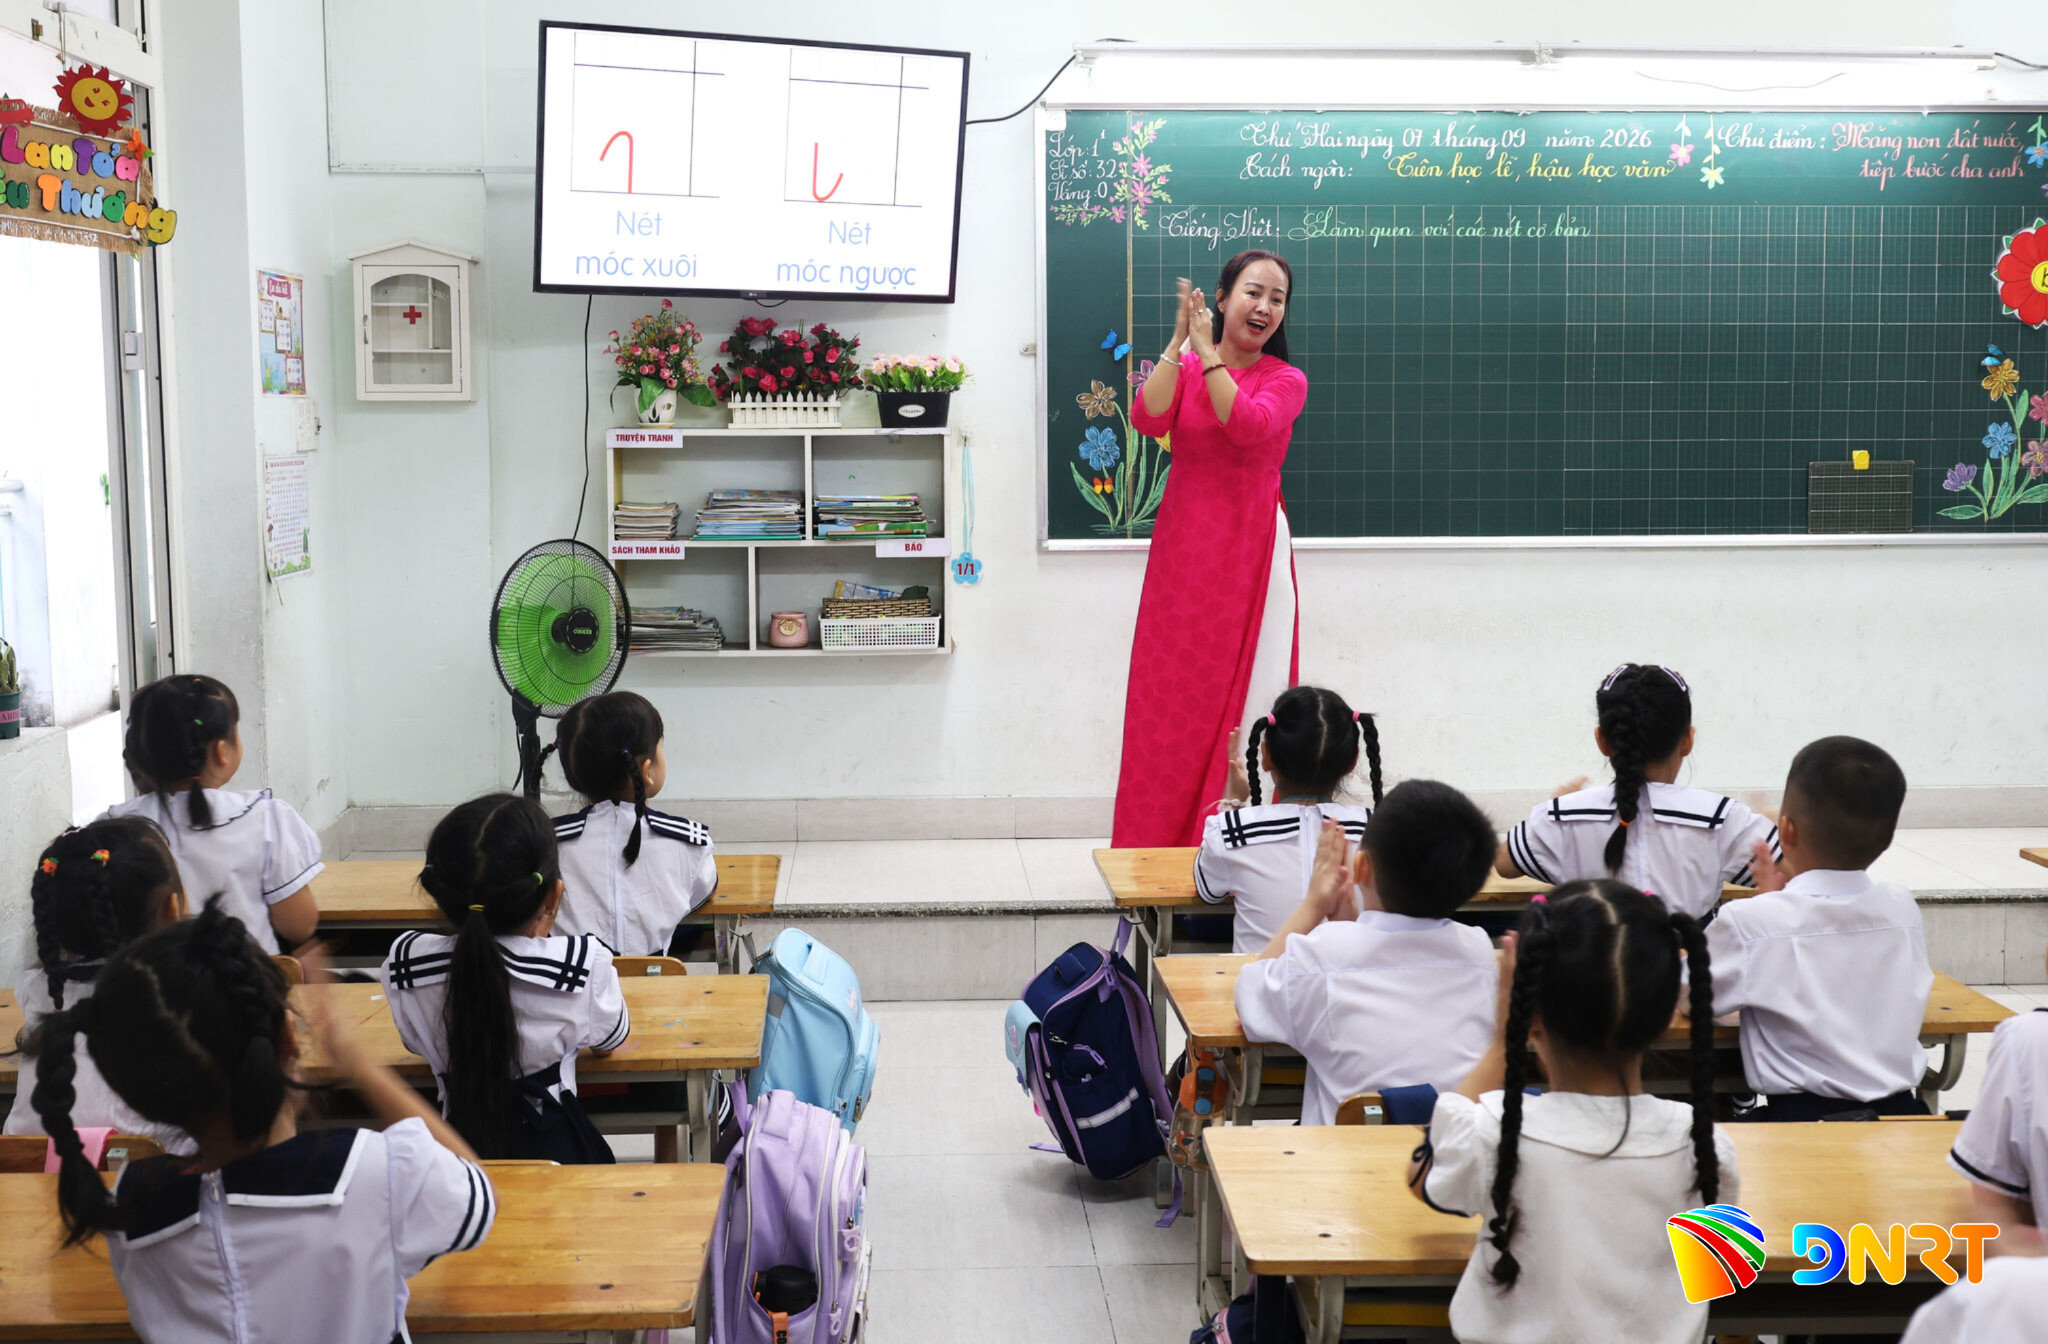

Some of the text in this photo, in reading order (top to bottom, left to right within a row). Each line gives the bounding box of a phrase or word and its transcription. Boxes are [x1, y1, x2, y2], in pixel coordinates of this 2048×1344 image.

[1240, 120, 1301, 147] Thứ
[1300, 121, 1343, 149] Hai
[1402, 128, 1423, 147] 07
[1430, 120, 1501, 160] tháng
[1501, 128, 1526, 148] 09
[1545, 128, 1595, 147] năm
[1599, 128, 1654, 148] 2026
[1717, 121, 1766, 148] Chủ
[1832, 121, 1902, 161] Măng
[1906, 135, 1941, 149] non
[1947, 119, 1980, 148] đất
[1096, 158, 1118, 179] 32
[1240, 151, 1353, 190] Cách ngôn:
[1387, 151, 1443, 178] Tiên
[1447, 151, 1483, 183] học
[1526, 152, 1572, 182] hậu
[1577, 152, 1618, 183] học
[1623, 158, 1676, 178] văn
[1859, 151, 2025, 191] tiếp bước cha anh
[37, 173, 178, 244] Thương
[616, 209, 662, 236] Nét
[828, 219, 872, 245] Nét
[1159, 210, 1221, 251] Tiếng
[1287, 206, 1591, 248] Làm quen với các nét cơ bản
[576, 250, 697, 278] móc xuôi
[777, 258, 916, 291] móc ngược
[616, 432, 673, 443] TRUYỆN TRANH
[612, 545, 681, 554] SÁCH THAM KHẢO
[904, 542, 923, 552] BÁO
[957, 562, 975, 576] 1/1
